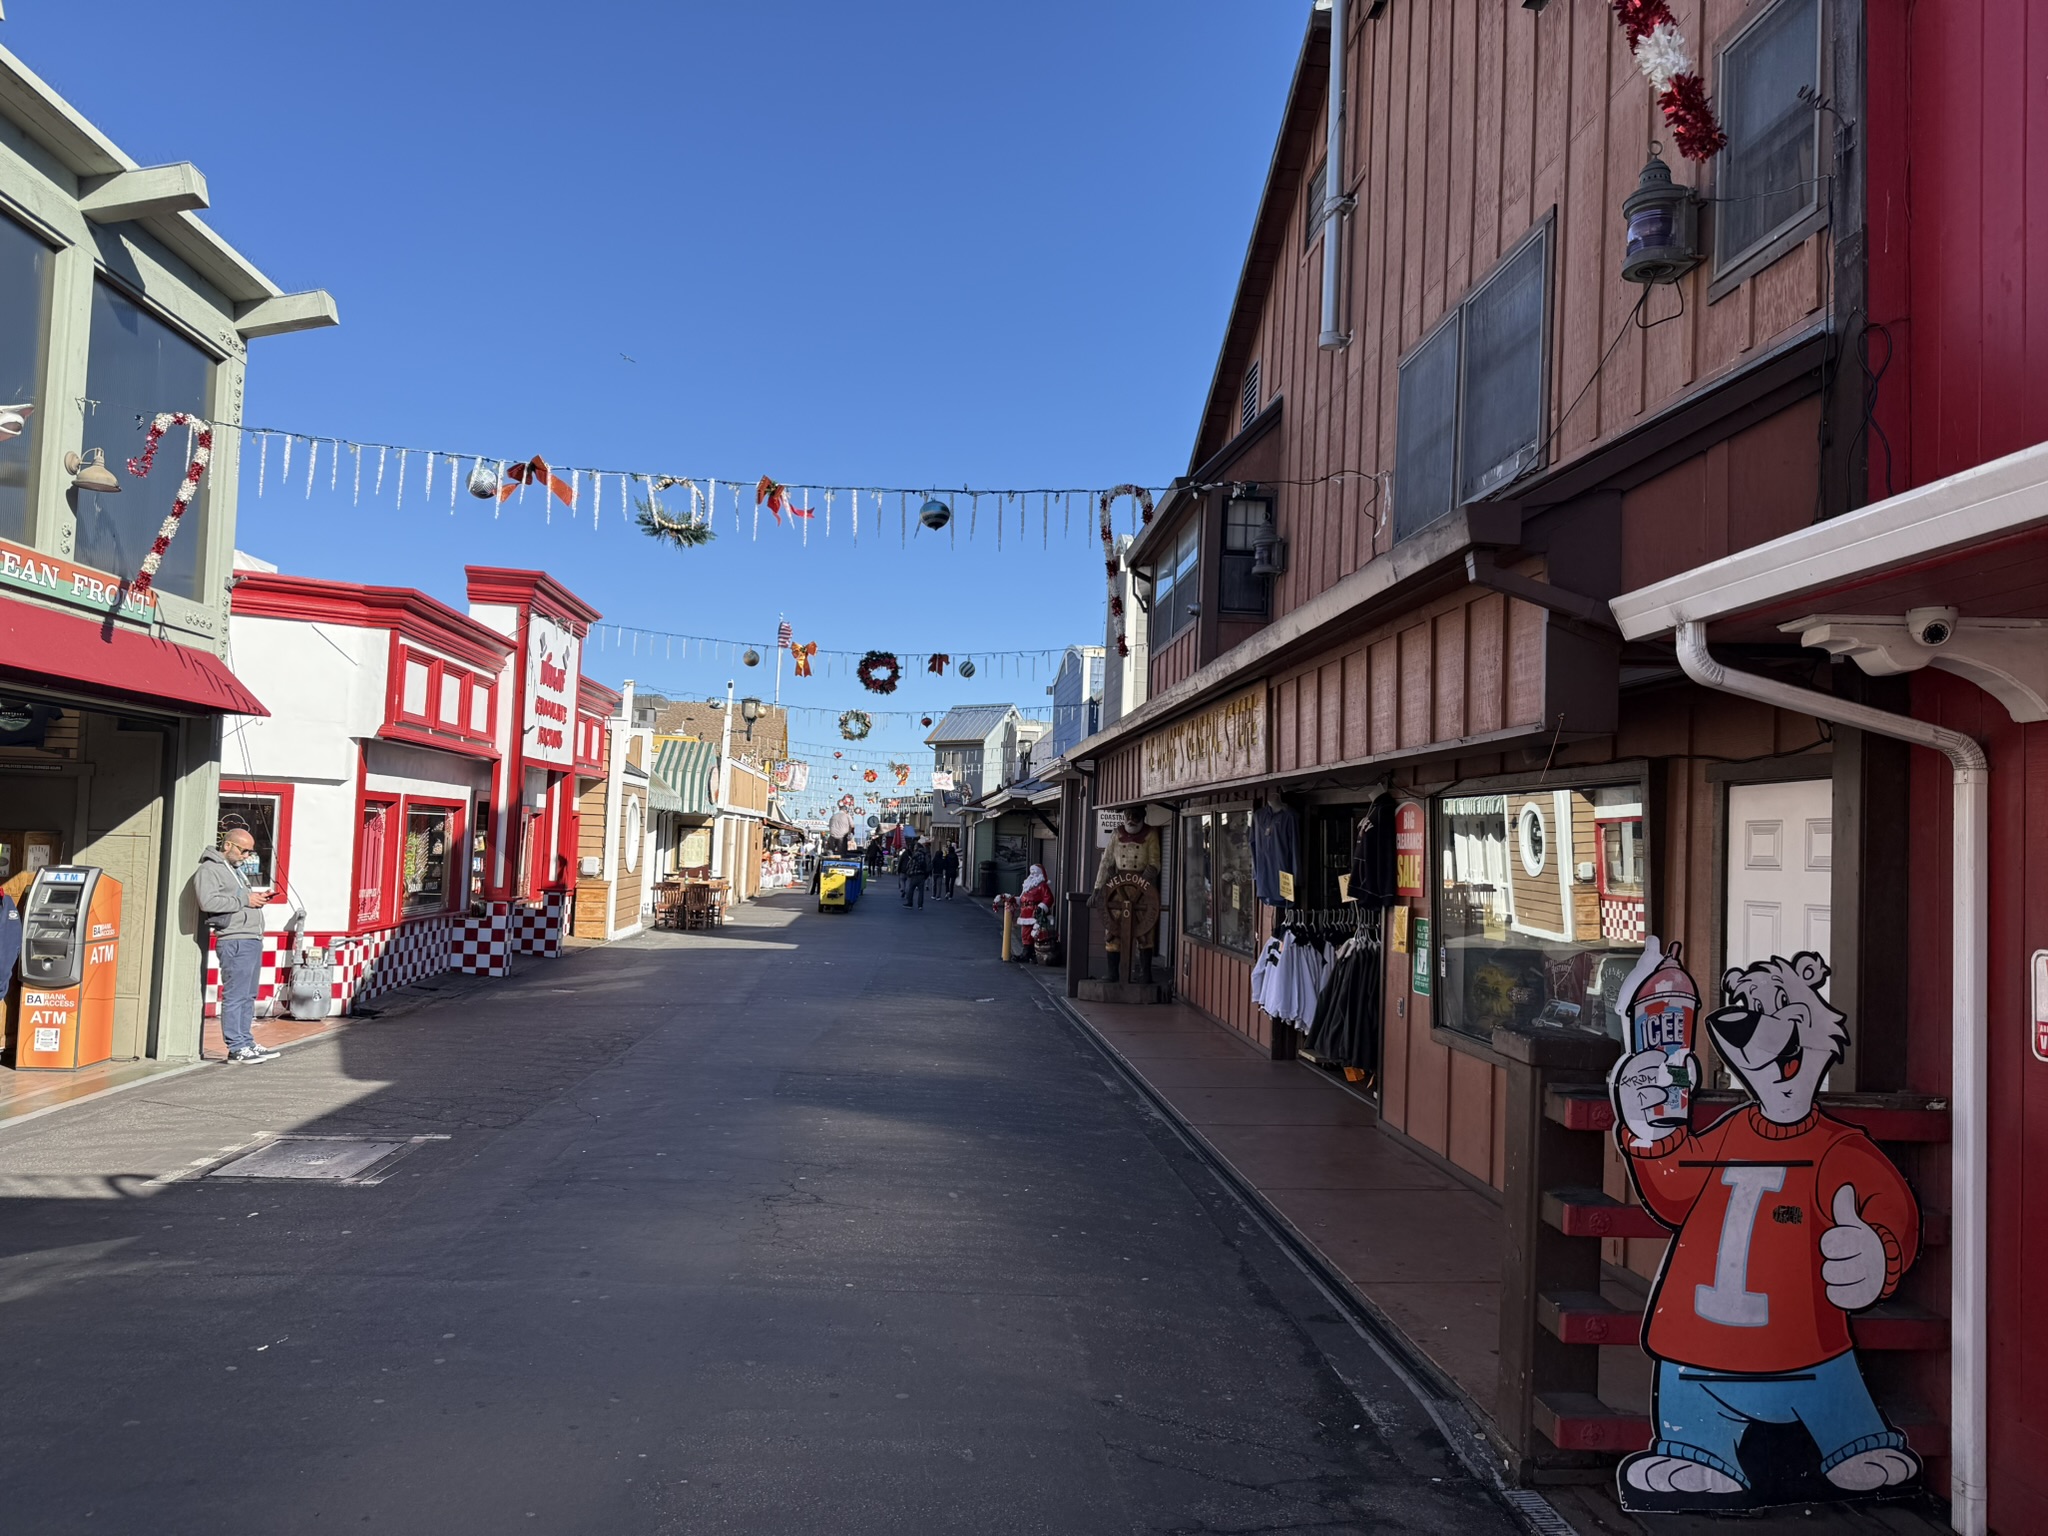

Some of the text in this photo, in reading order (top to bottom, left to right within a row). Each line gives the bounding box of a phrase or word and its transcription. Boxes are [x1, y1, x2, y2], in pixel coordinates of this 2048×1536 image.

[71, 572, 150, 616] FRONT
[1403, 811, 1415, 829] BIG
[1396, 832, 1423, 850] CLEARANCE
[54, 873, 78, 881] ATM
[1397, 855, 1421, 889] SALE
[1105, 873, 1150, 890] WELCOME
[1123, 900, 1130, 918] TO
[93, 926, 102, 936] BA
[90, 944, 114, 965] ATM
[26, 993, 67, 1005] BA BANK
[43, 1000, 75, 1008] ACCESS
[30, 1011, 67, 1024] ATM
[1641, 1012, 1685, 1049] ICEE
[1695, 1158, 1787, 1327] I
